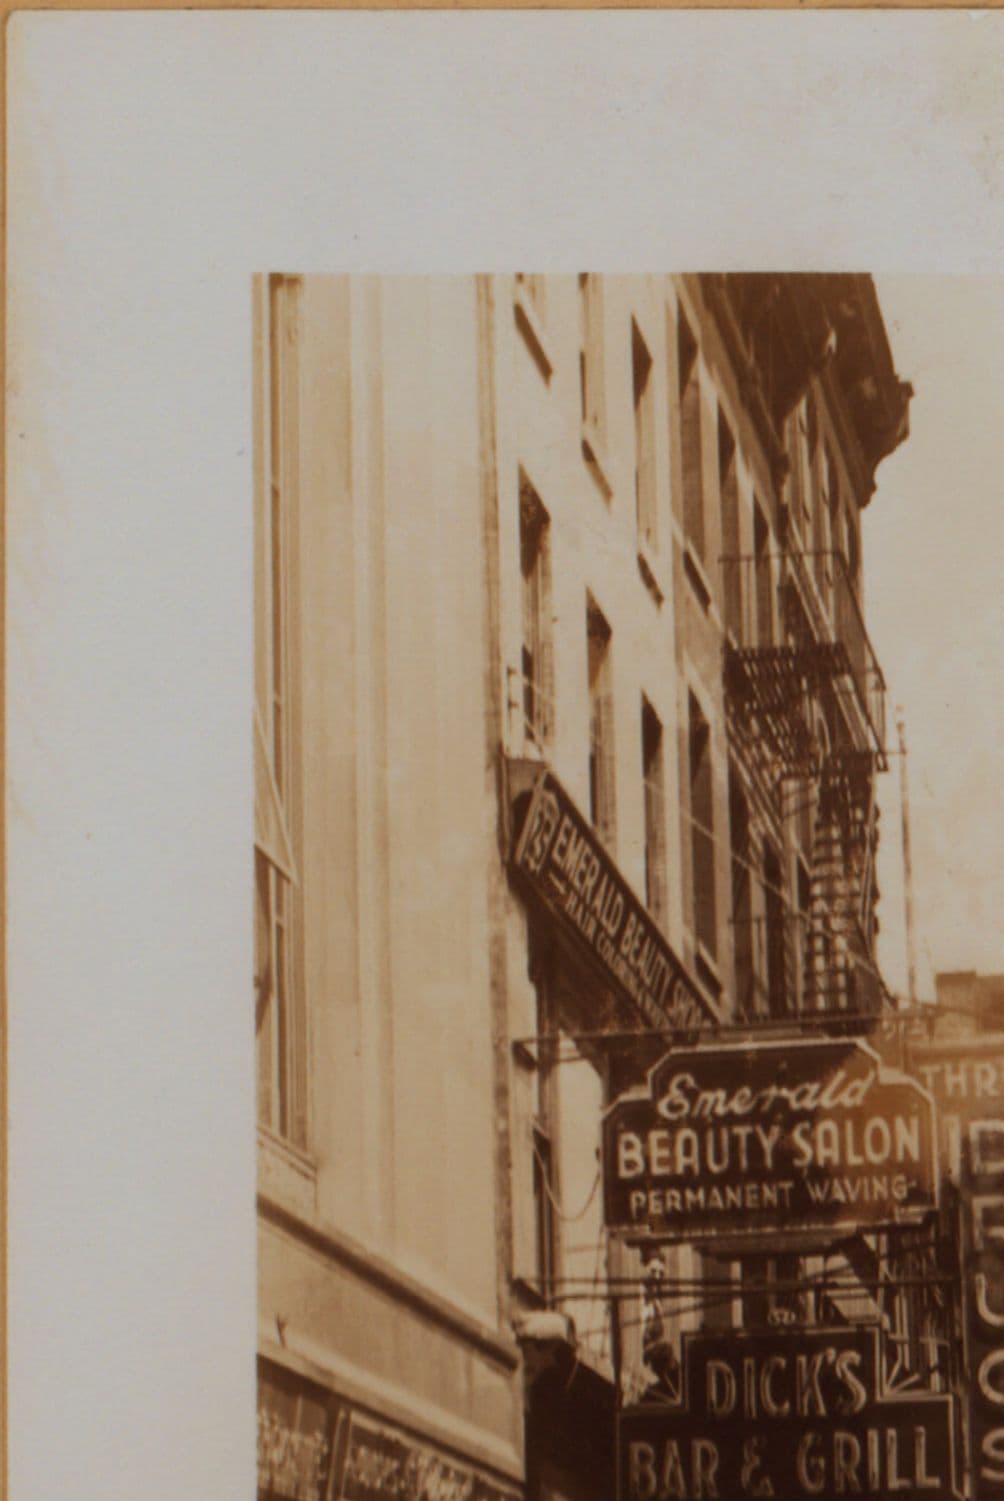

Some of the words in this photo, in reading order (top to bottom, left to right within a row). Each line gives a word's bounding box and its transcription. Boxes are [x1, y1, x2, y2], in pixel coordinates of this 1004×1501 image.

[552, 812, 625, 937] EMERALD
[620, 911, 673, 1006] BEAUTY
[657, 1068, 877, 1121] Emerald
[617, 1124, 780, 1179] BEAUTY
[793, 1115, 921, 1167] SALON
[630, 1181, 795, 1217] PERMANENT
[804, 1174, 908, 1203] WAVING
[706, 1346, 868, 1419] DICK'S
[629, 1439, 721, 1501] BAR
[741, 1435, 776, 1497] &
[798, 1425, 942, 1492] GRILL
